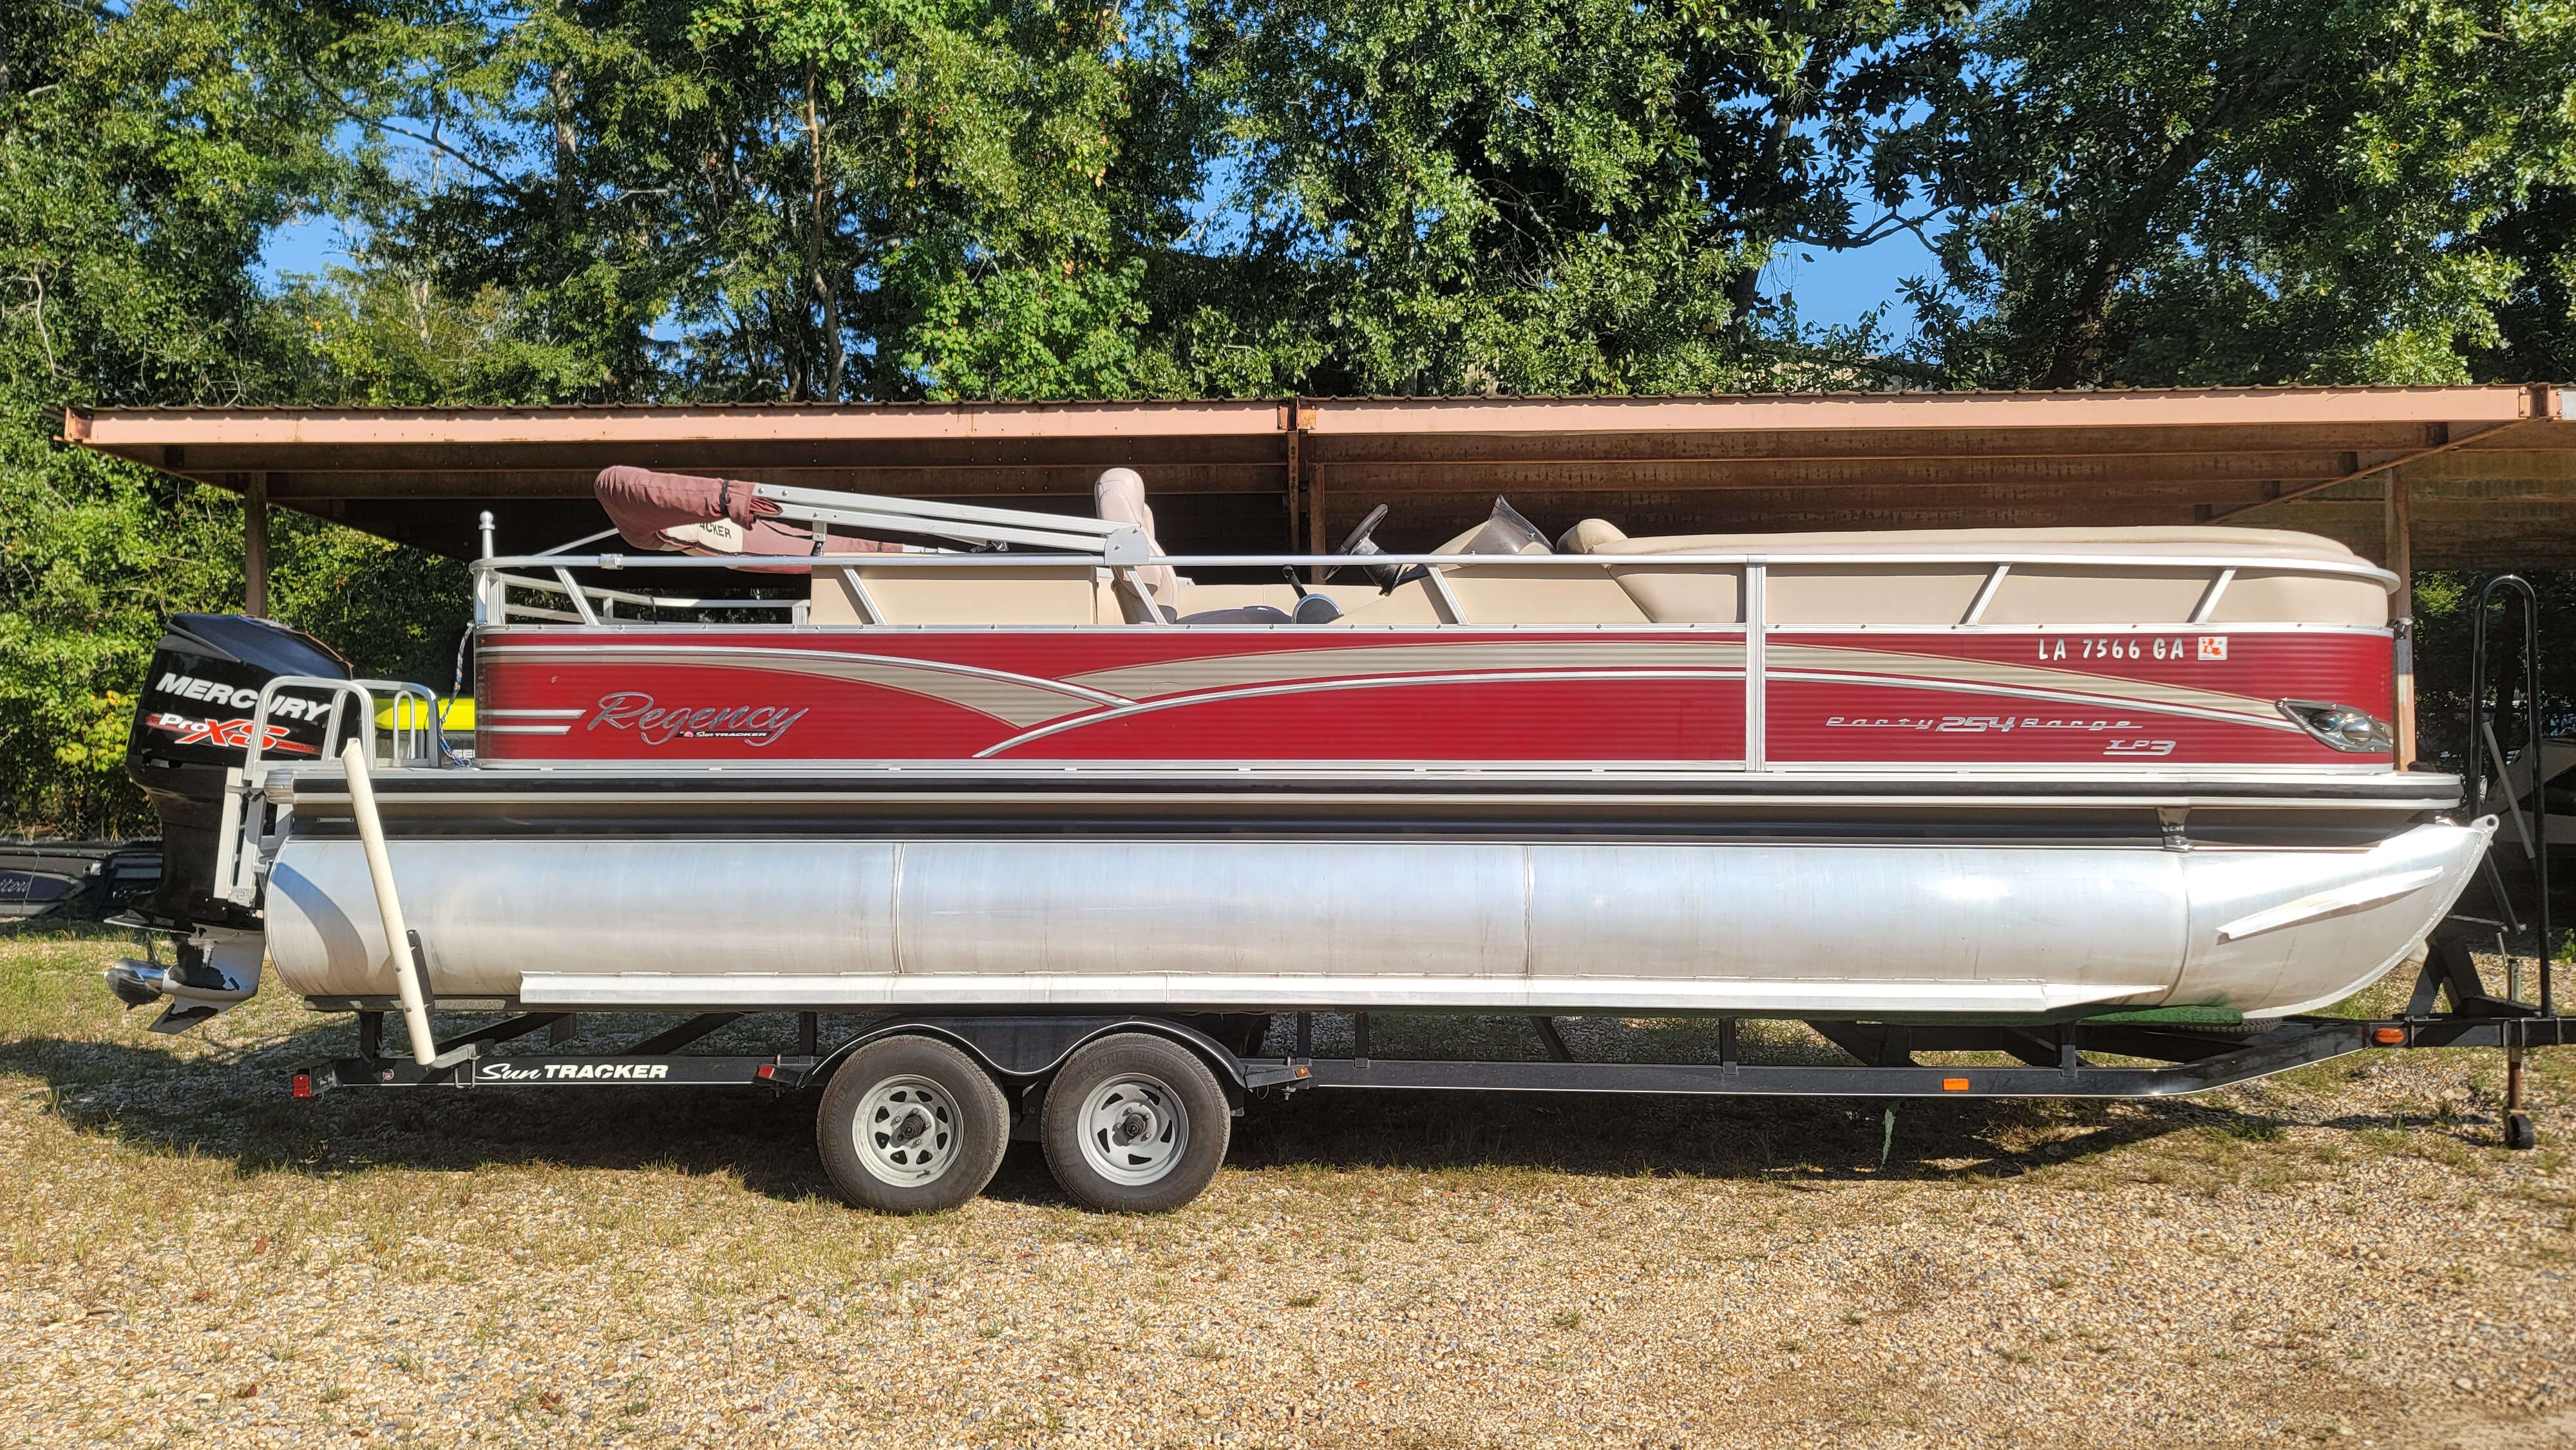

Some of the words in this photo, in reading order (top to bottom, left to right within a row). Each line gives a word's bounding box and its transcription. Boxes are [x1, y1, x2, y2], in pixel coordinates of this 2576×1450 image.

[692, 522, 732, 540] ACKER
[2038, 638, 2067, 661] LA
[2082, 638, 2141, 659] 7566
[2152, 637, 2184, 660] GA
[587, 692, 810, 747] Regency
[1825, 717, 1933, 730] Party
[1935, 717, 2016, 732] 254
[2020, 717, 2143, 731] Barge
[475, 1062, 542, 1080] Sun
[544, 1064, 668, 1079] TRACKER
